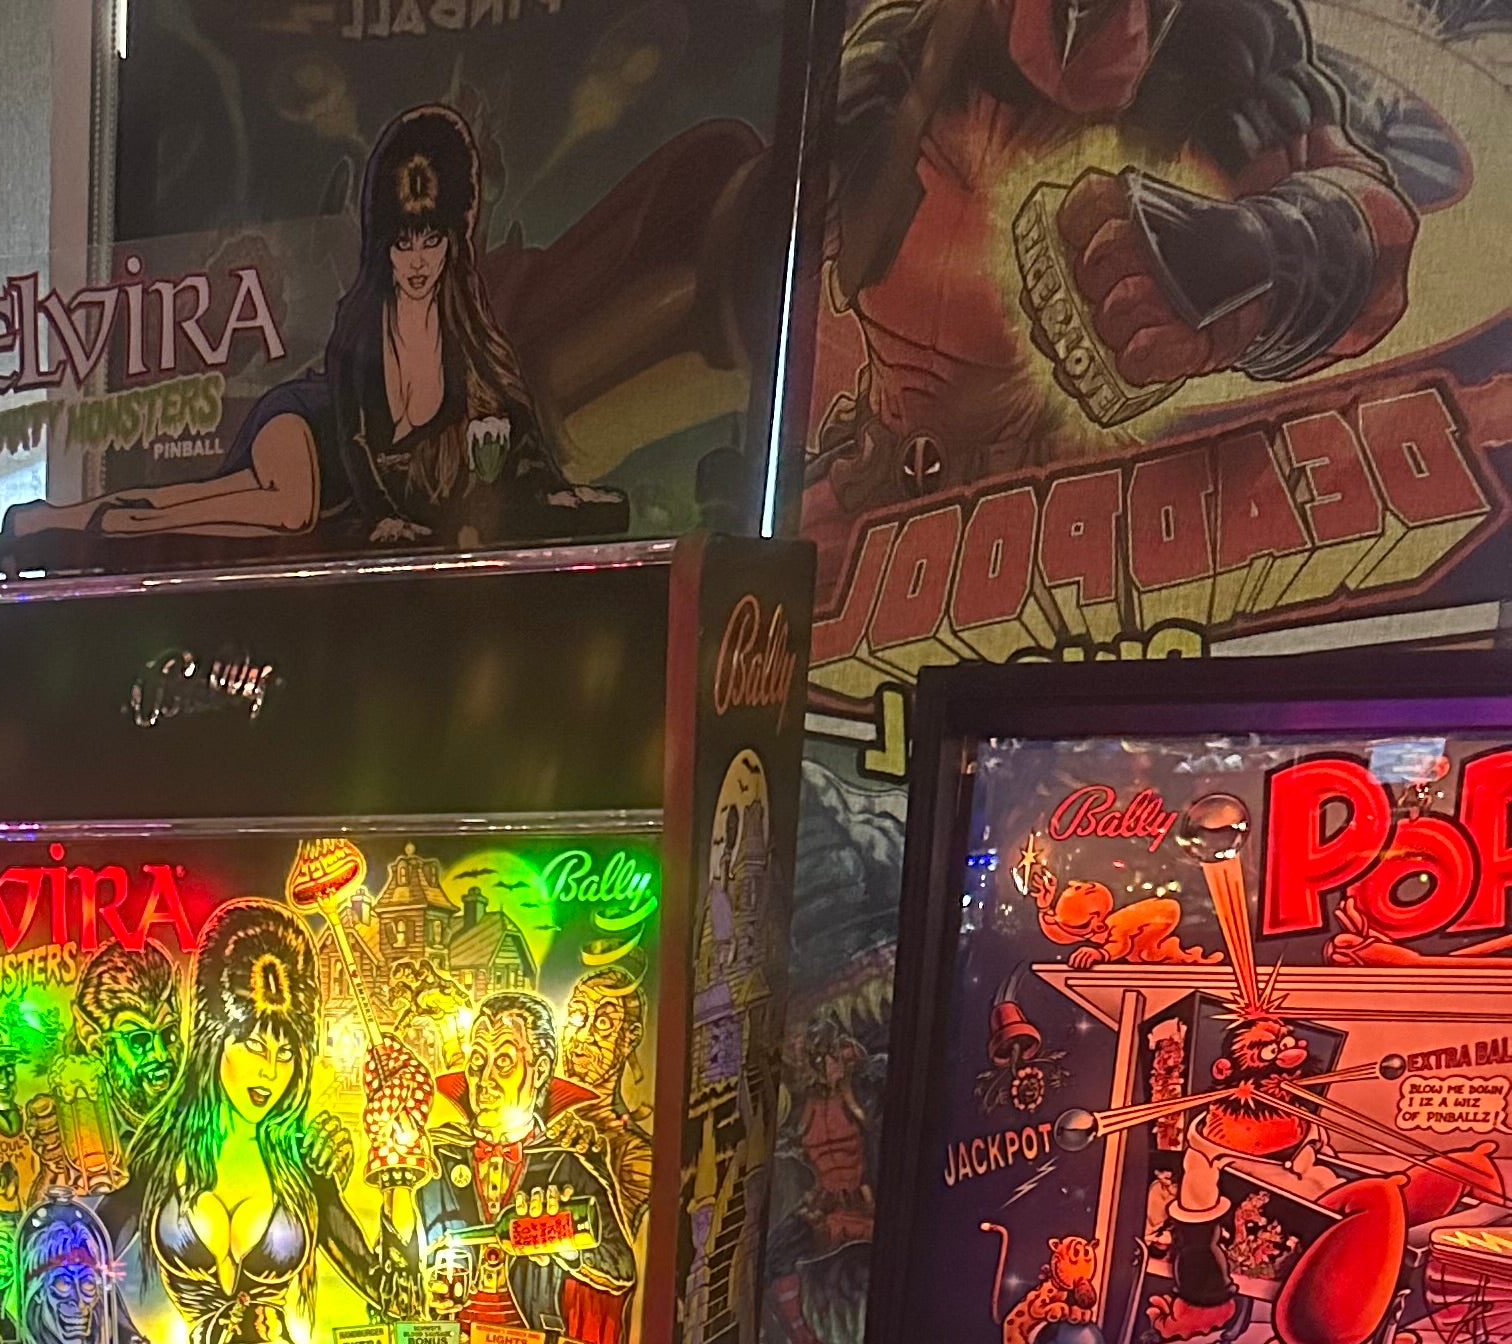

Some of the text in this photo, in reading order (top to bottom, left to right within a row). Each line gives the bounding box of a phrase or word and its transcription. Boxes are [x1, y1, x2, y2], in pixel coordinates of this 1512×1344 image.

[153, 438, 225, 461] PINBALL
[713, 593, 797, 737] Bally
[1049, 784, 1182, 852] Bally
[539, 849, 654, 911] Bally
[1407, 1043, 1472, 1073] EXTRA
[1408, 1083, 1504, 1096] BLOW ME DOWN
[1418, 1097, 1434, 1108] IZ
[1437, 1096, 1448, 1108] A
[1453, 1097, 1481, 1108] WIZ
[1401, 1111, 1421, 1122] OF
[943, 1123, 1053, 1187] JACKPOT
